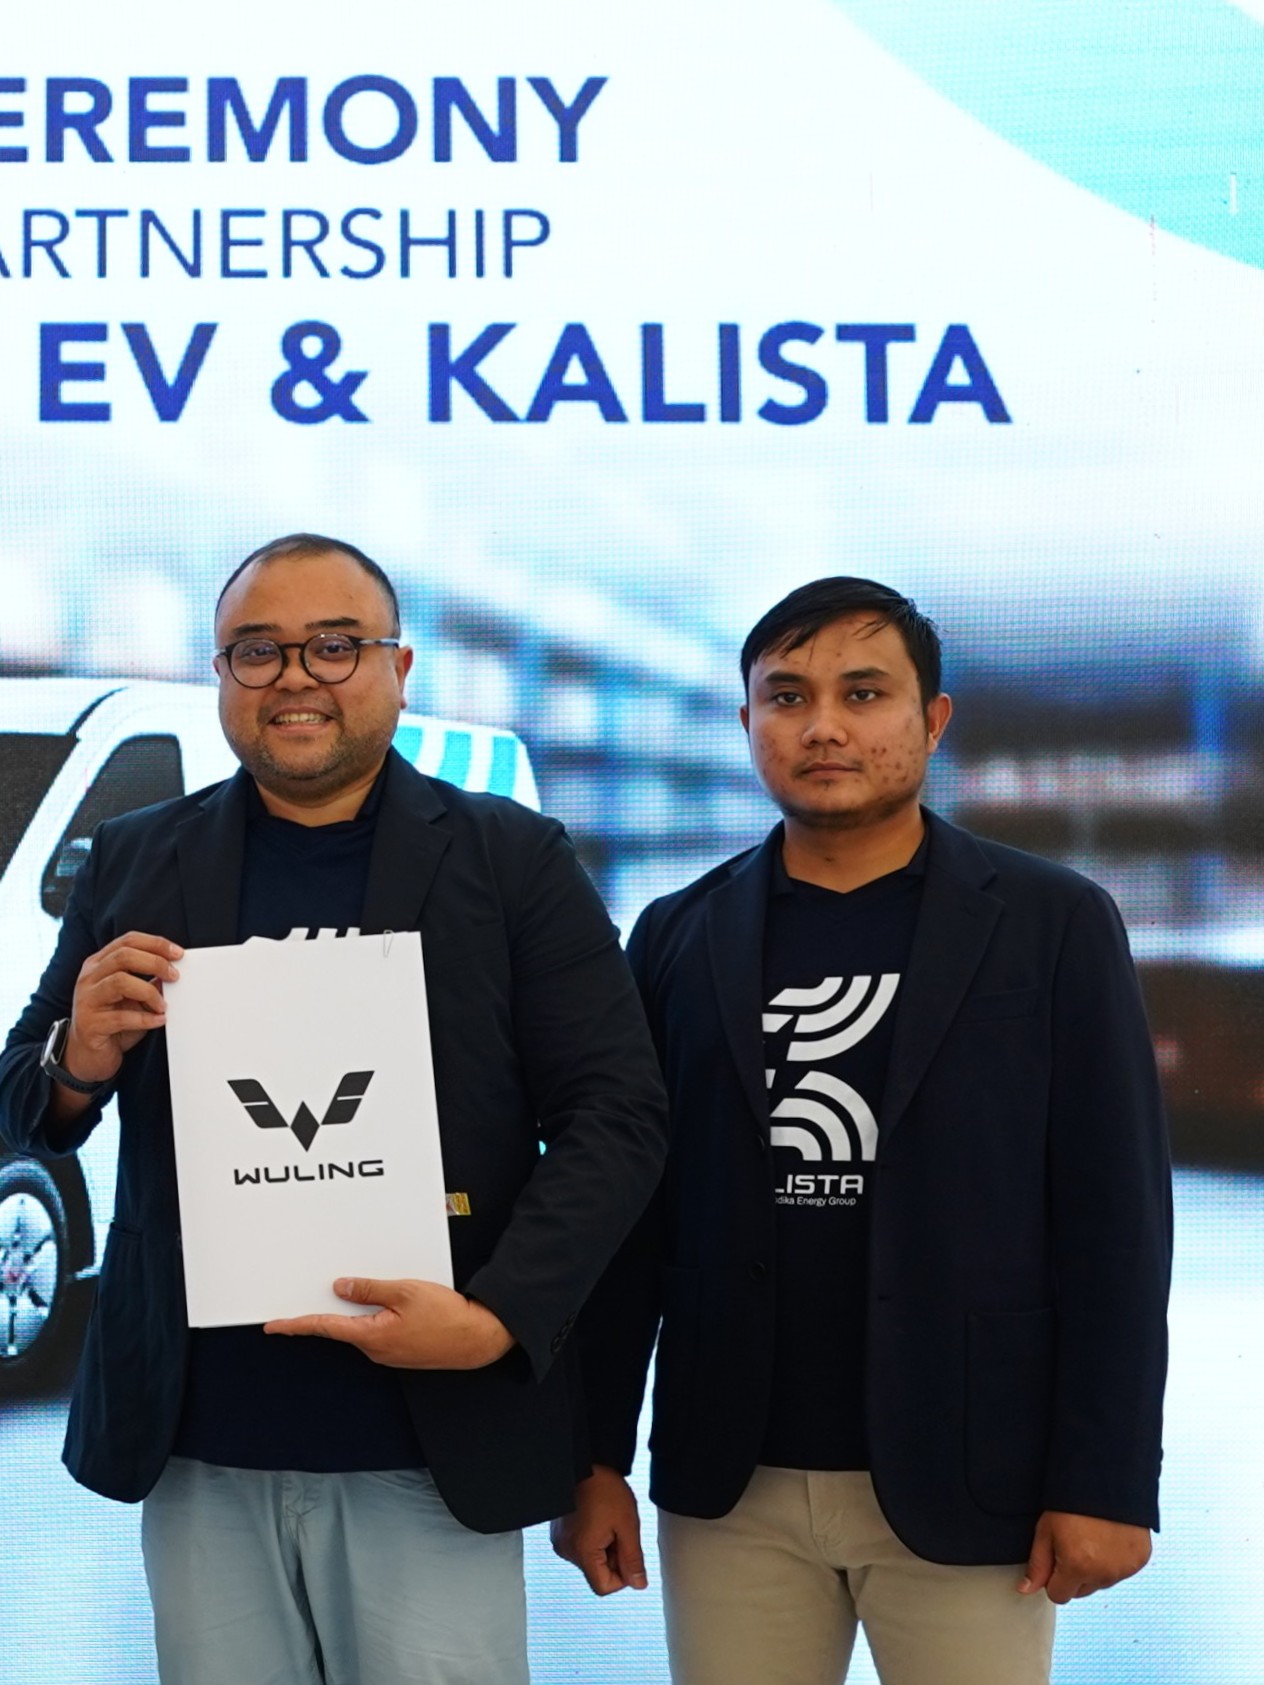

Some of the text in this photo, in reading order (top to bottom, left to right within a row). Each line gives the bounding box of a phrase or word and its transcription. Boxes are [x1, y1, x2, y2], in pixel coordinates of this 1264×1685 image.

[39, 322, 218, 424] EV
[269, 319, 371, 425] &
[428, 320, 1012, 426] KALISTA
[234, 1159, 384, 1185] WULING
[774, 1174, 864, 1194] ISTA
[776, 1196, 857, 1207] dika Energy Group
